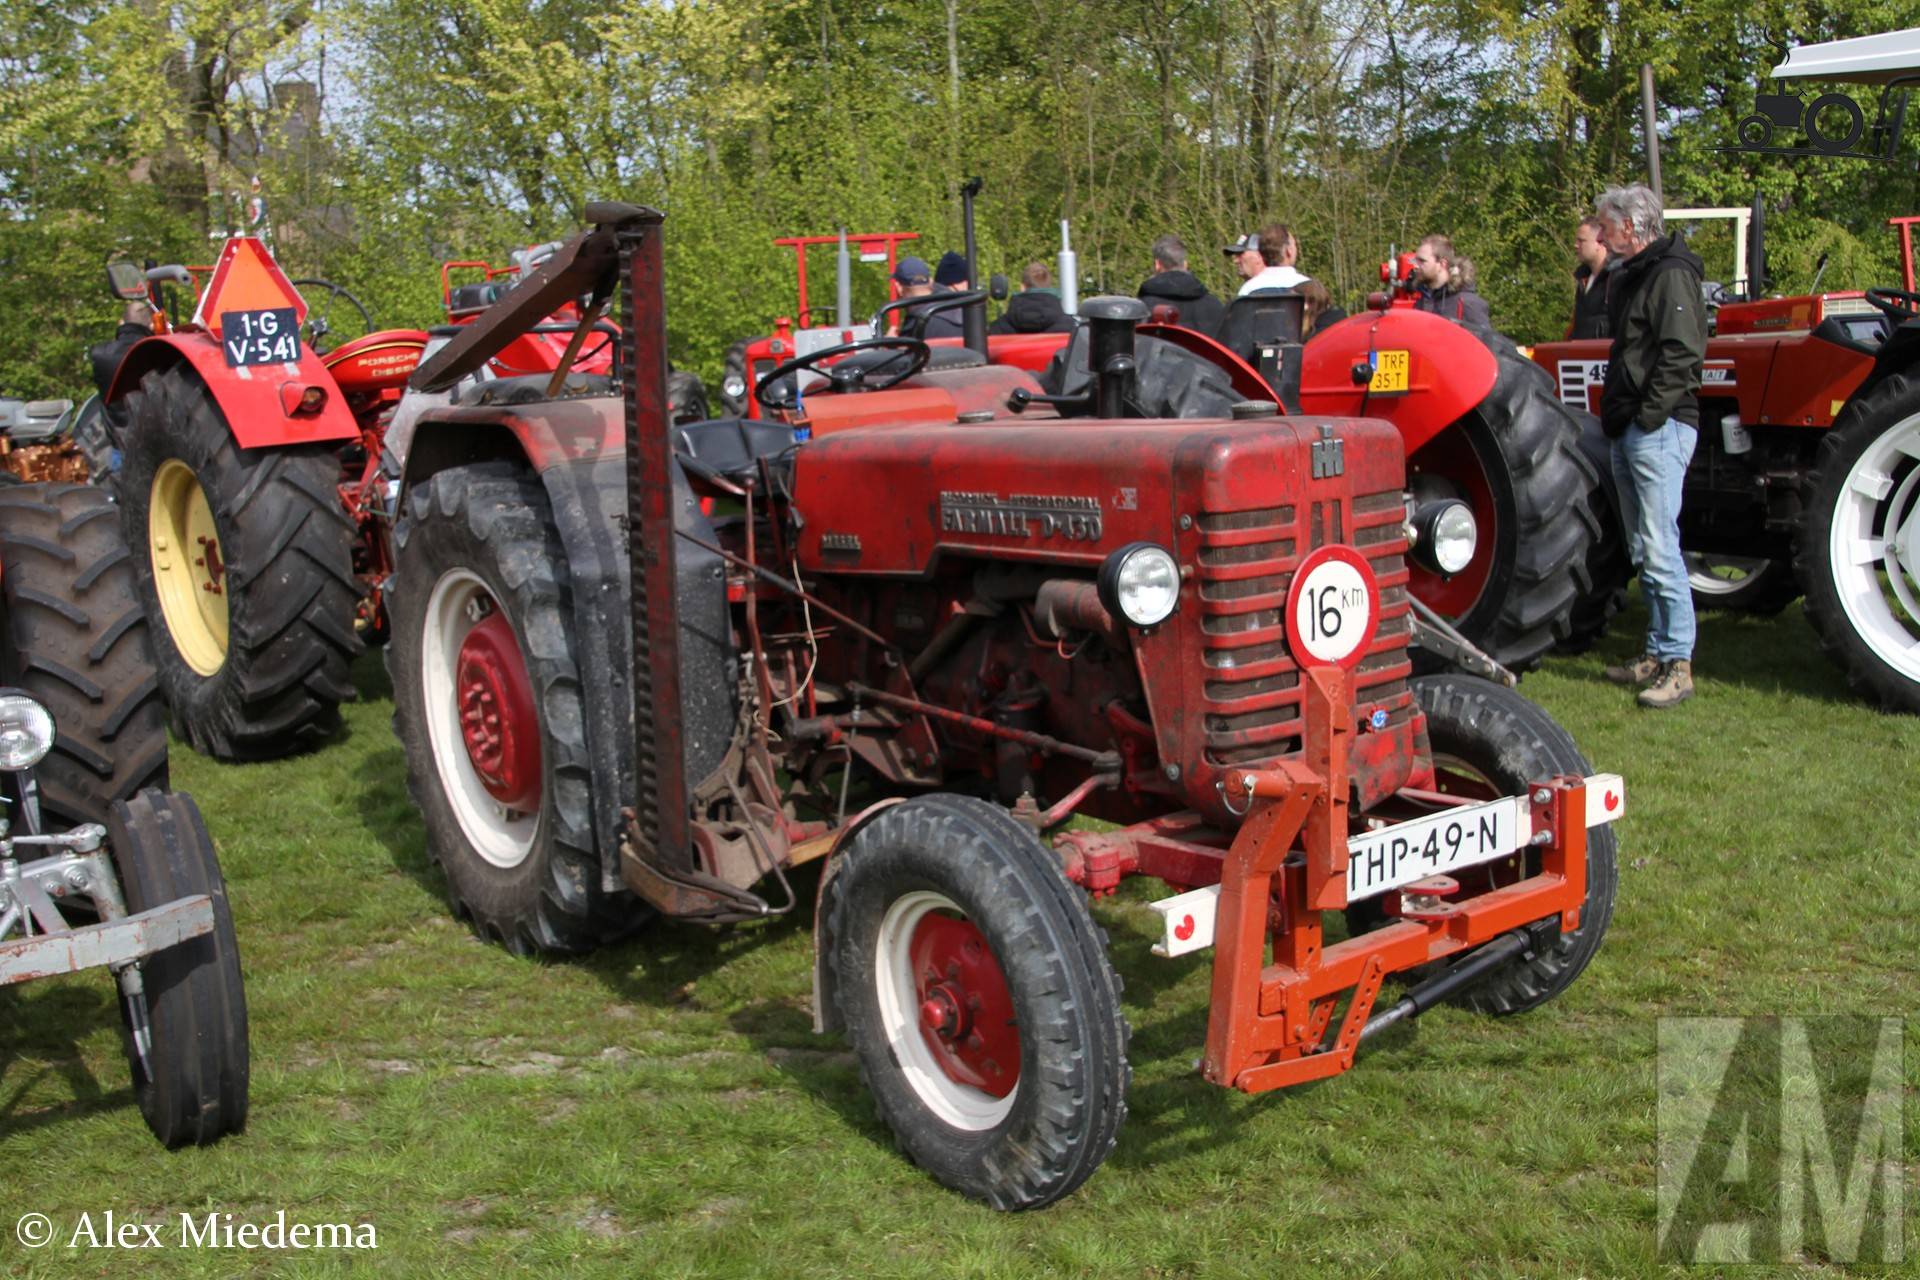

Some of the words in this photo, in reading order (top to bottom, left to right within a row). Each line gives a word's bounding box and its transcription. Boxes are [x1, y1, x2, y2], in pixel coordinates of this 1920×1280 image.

[1383, 353, 1405, 369] TRF
[940, 507, 1031, 538] FARMALL
[1307, 586, 1342, 642] 16
[1350, 812, 1497, 892] THP-49-N
